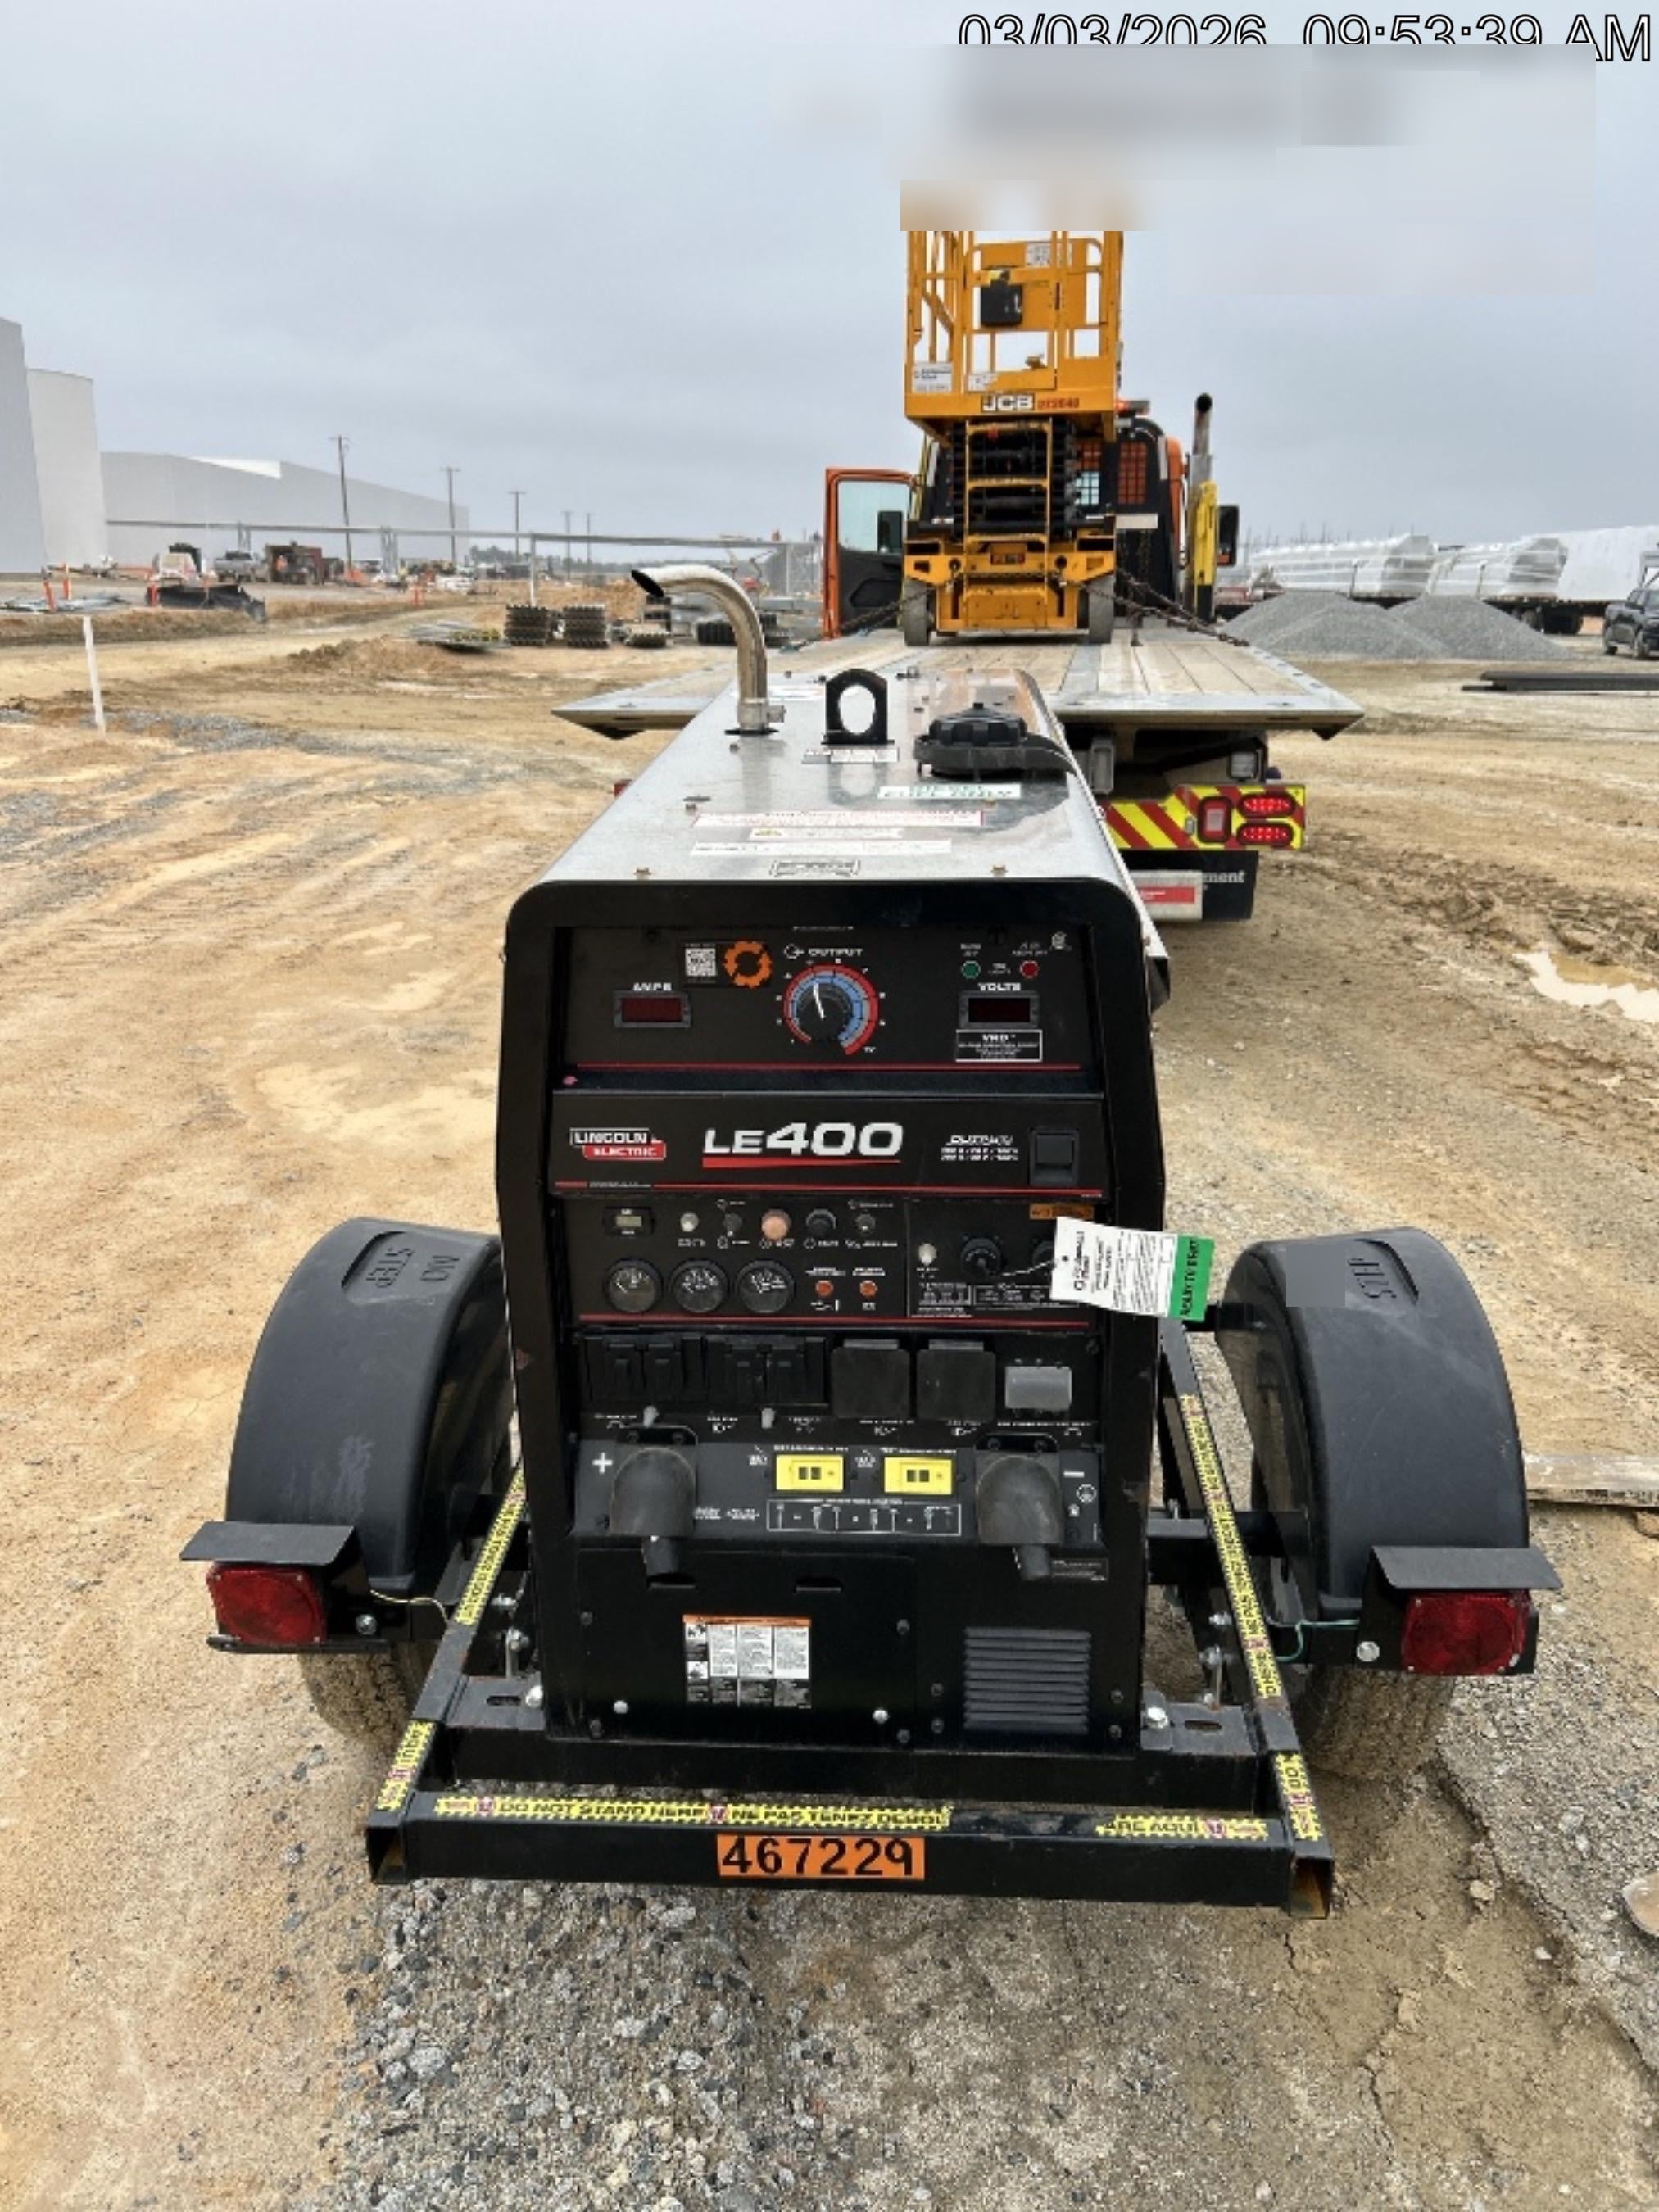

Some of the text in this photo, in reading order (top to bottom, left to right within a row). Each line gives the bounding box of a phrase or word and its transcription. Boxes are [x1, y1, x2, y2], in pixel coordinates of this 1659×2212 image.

[982, 395, 1034, 411] JCB
[808, 948, 863, 957] OUTPUT
[633, 982, 673, 991] AMPS
[978, 982, 1021, 992] VOLTS
[574, 1132, 647, 1144] LINCOLN
[703, 1122, 904, 1156] LE400
[593, 1147, 658, 1157] ELECTRIC
[499, 1803, 528, 1812] DO
[533, 1804, 573, 1814] NOT
[579, 1804, 645, 1815] STAND
[732, 1811, 759, 1820] NE
[764, 1811, 805, 1820] PAS
[809, 1812, 872, 1823] TENEZ
[721, 1837, 913, 1876] 467229
